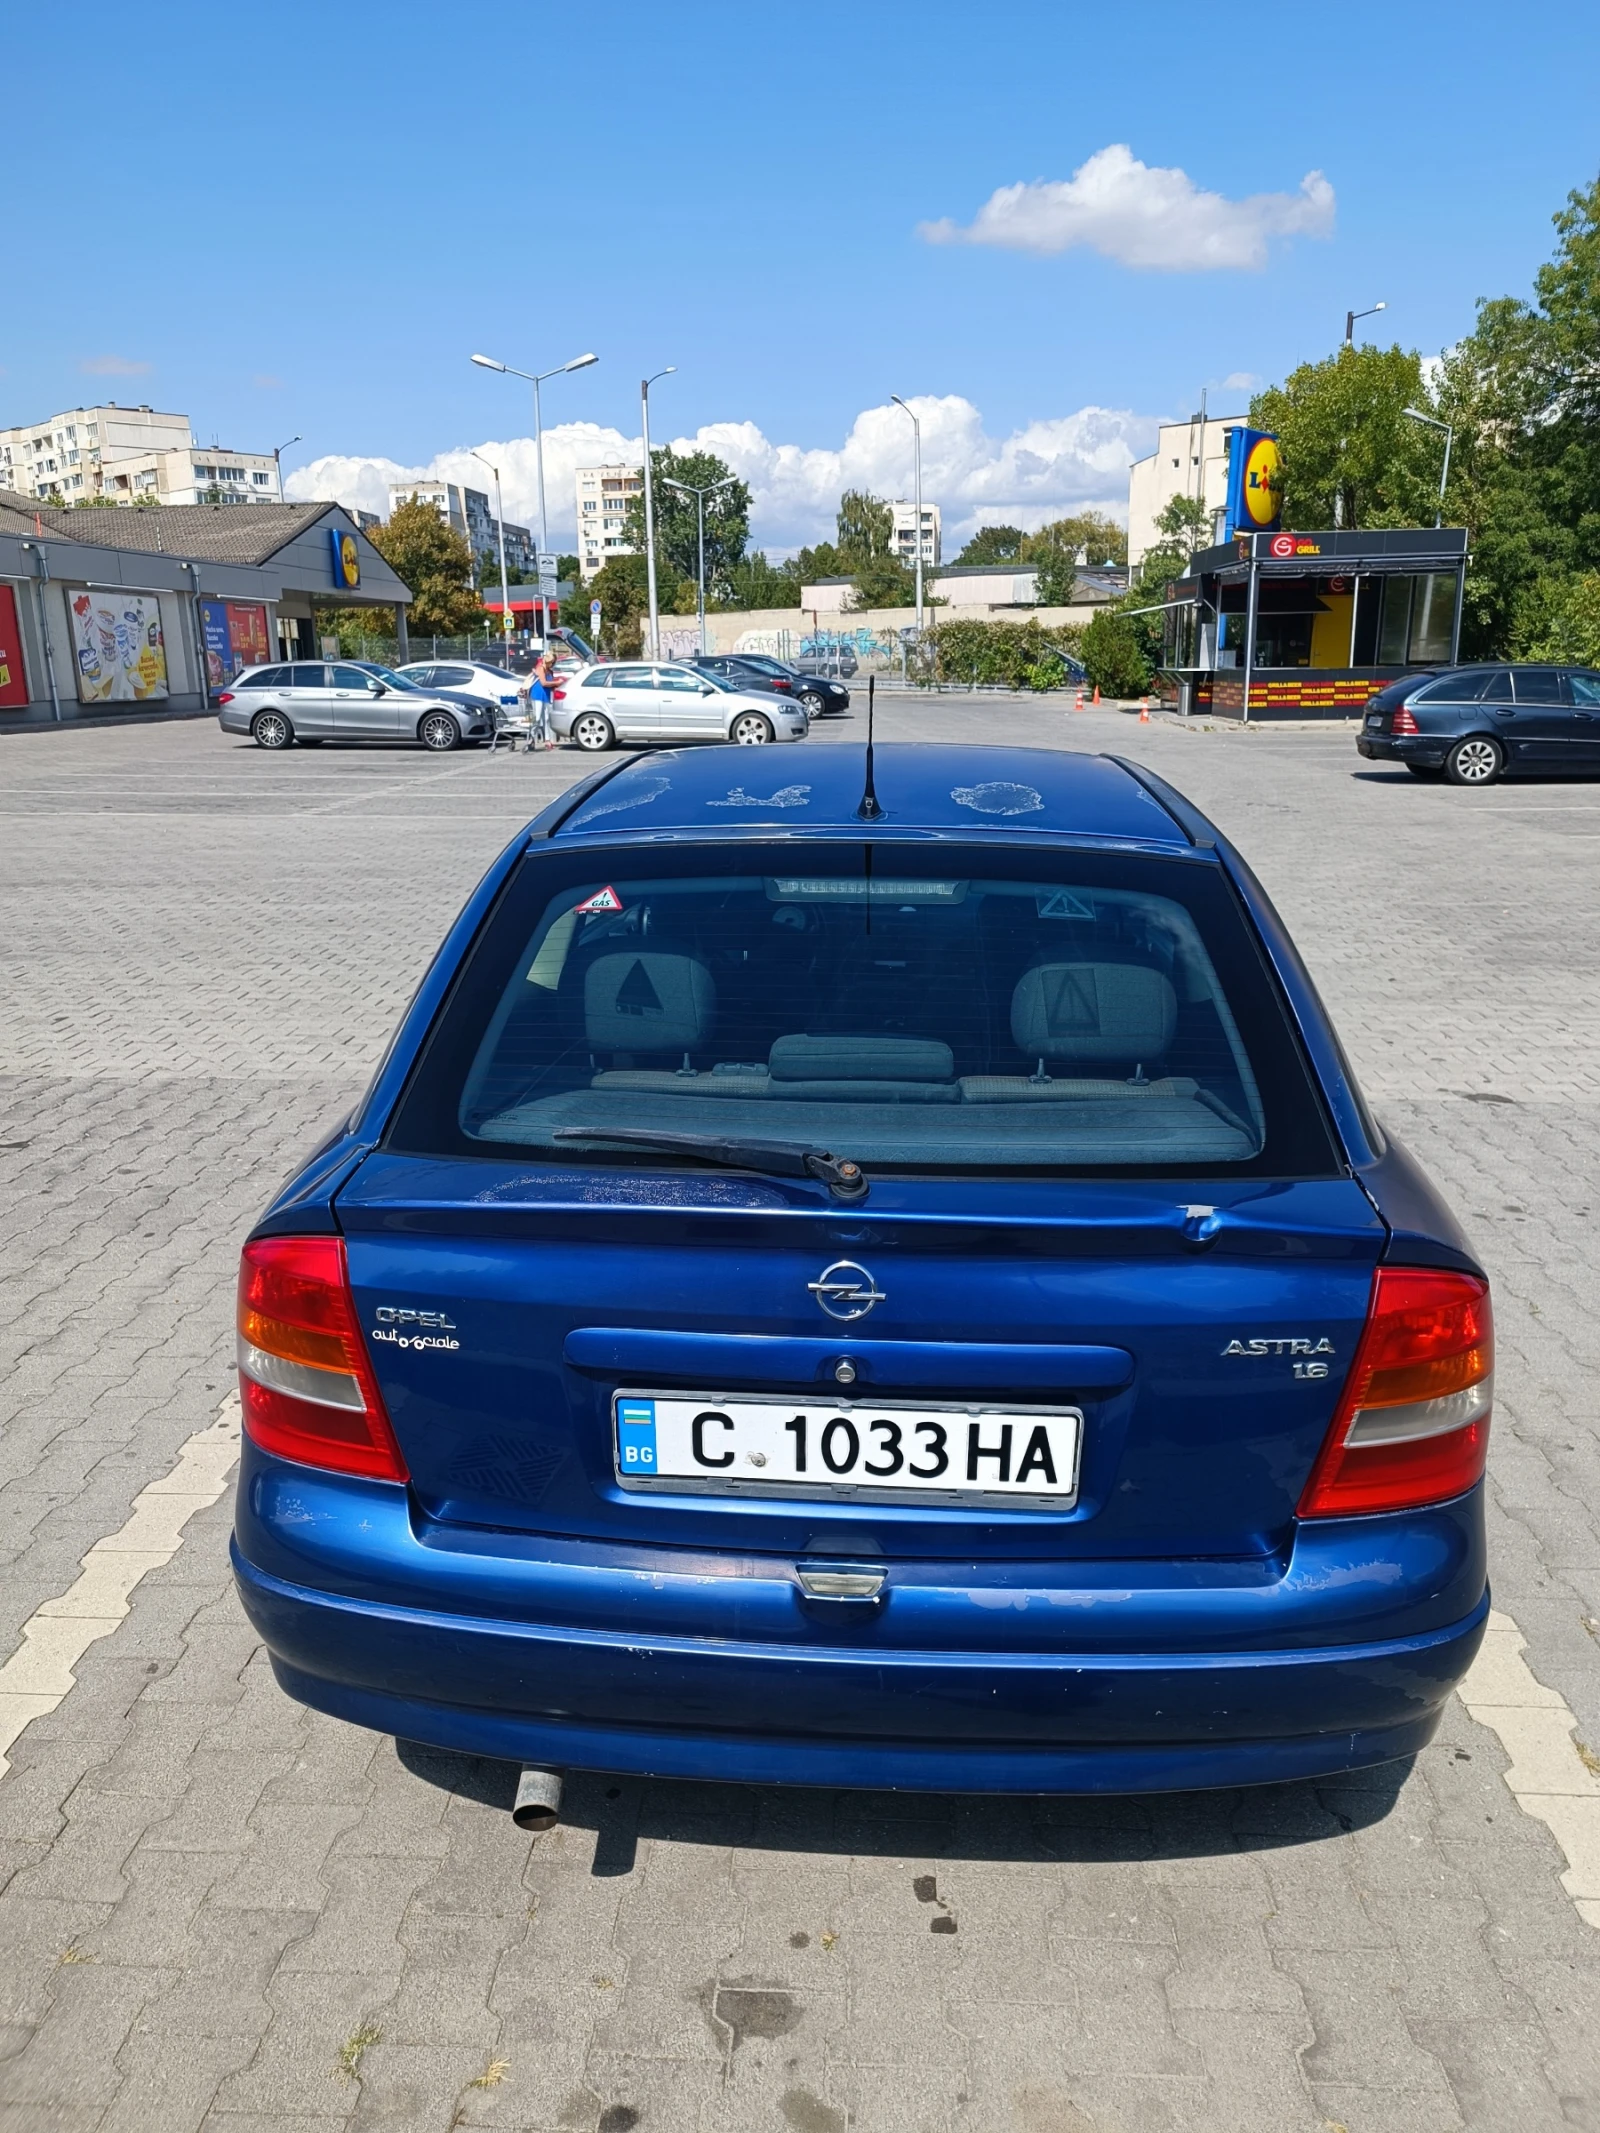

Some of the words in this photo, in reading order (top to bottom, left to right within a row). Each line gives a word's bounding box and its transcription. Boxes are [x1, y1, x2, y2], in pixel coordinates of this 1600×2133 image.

[1297, 545, 1320, 554] GRILL
[592, 899, 611, 907] GAS
[376, 1306, 457, 1329] OPEL
[1220, 1338, 1336, 1355] ASTRA
[691, 1410, 735, 1468] C
[625, 1446, 653, 1463] BG
